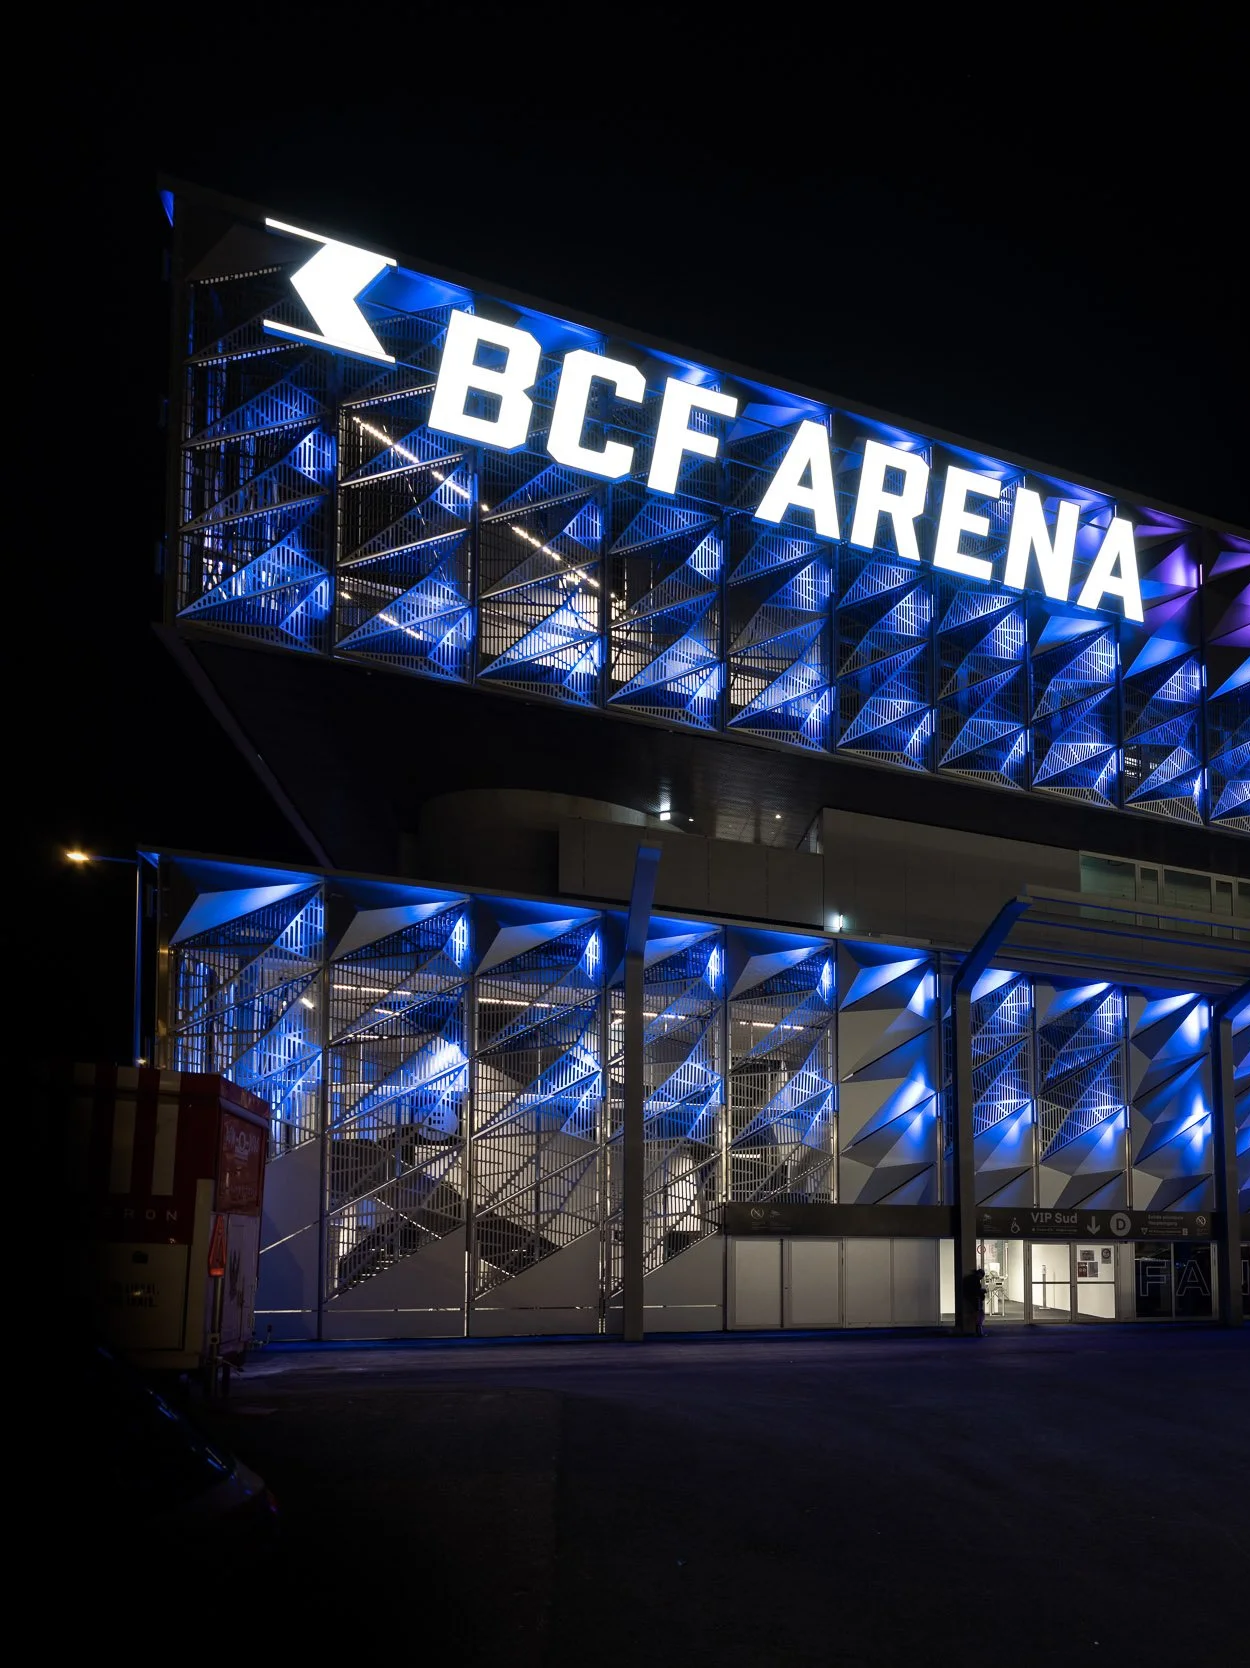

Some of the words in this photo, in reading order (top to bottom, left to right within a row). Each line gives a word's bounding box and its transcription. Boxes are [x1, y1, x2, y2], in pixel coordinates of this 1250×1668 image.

[427, 308, 738, 494] BCF
[755, 420, 1144, 622] ARENA
[1031, 1212, 1052, 1223] VIP
[1055, 1212, 1078, 1224] Sud
